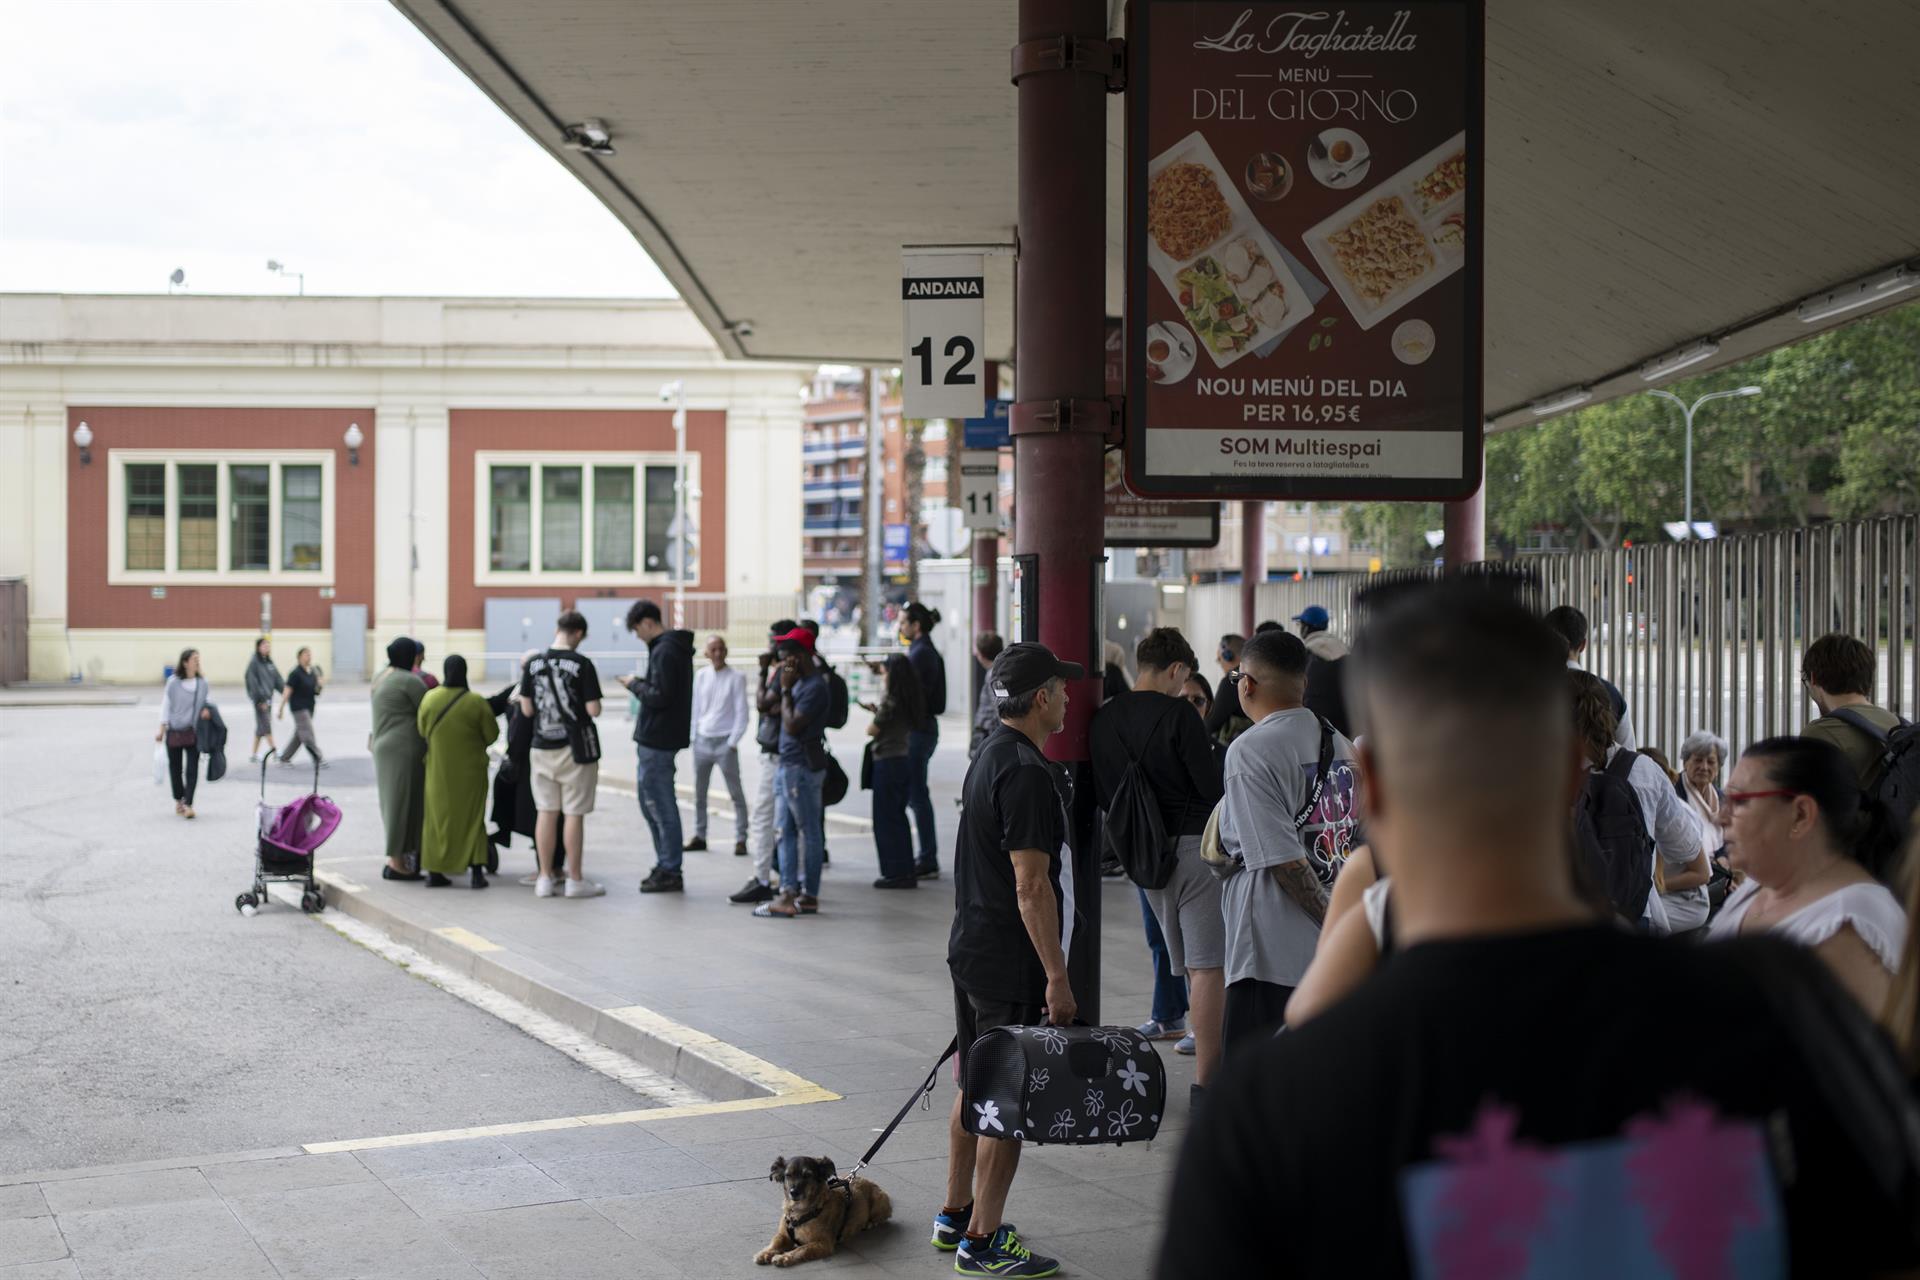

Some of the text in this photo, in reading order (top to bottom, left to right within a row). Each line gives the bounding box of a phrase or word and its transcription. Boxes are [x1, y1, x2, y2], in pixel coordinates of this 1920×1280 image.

[1193, 8, 1417, 60] La Tagliatella
[1278, 66, 1330, 83] MENÚ
[1192, 88, 1418, 124] DEL GIORNO
[907, 280, 980, 296] ANDANA
[911, 335, 977, 386] 12
[1196, 375, 1408, 398] NOU MENÚ DEL DIA
[1243, 404, 1361, 424] PER 16,95€
[1219, 437, 1382, 459] SOM Multiespai
[1233, 460, 1247, 468] Fes
[1248, 460, 1256, 468] la
[1257, 460, 1275, 468] teva
[1275, 461, 1305, 469] reserva
[1313, 460, 1370, 471] latagliatella.es
[966, 491, 993, 514] 11
[1294, 804, 1314, 828] mbro
